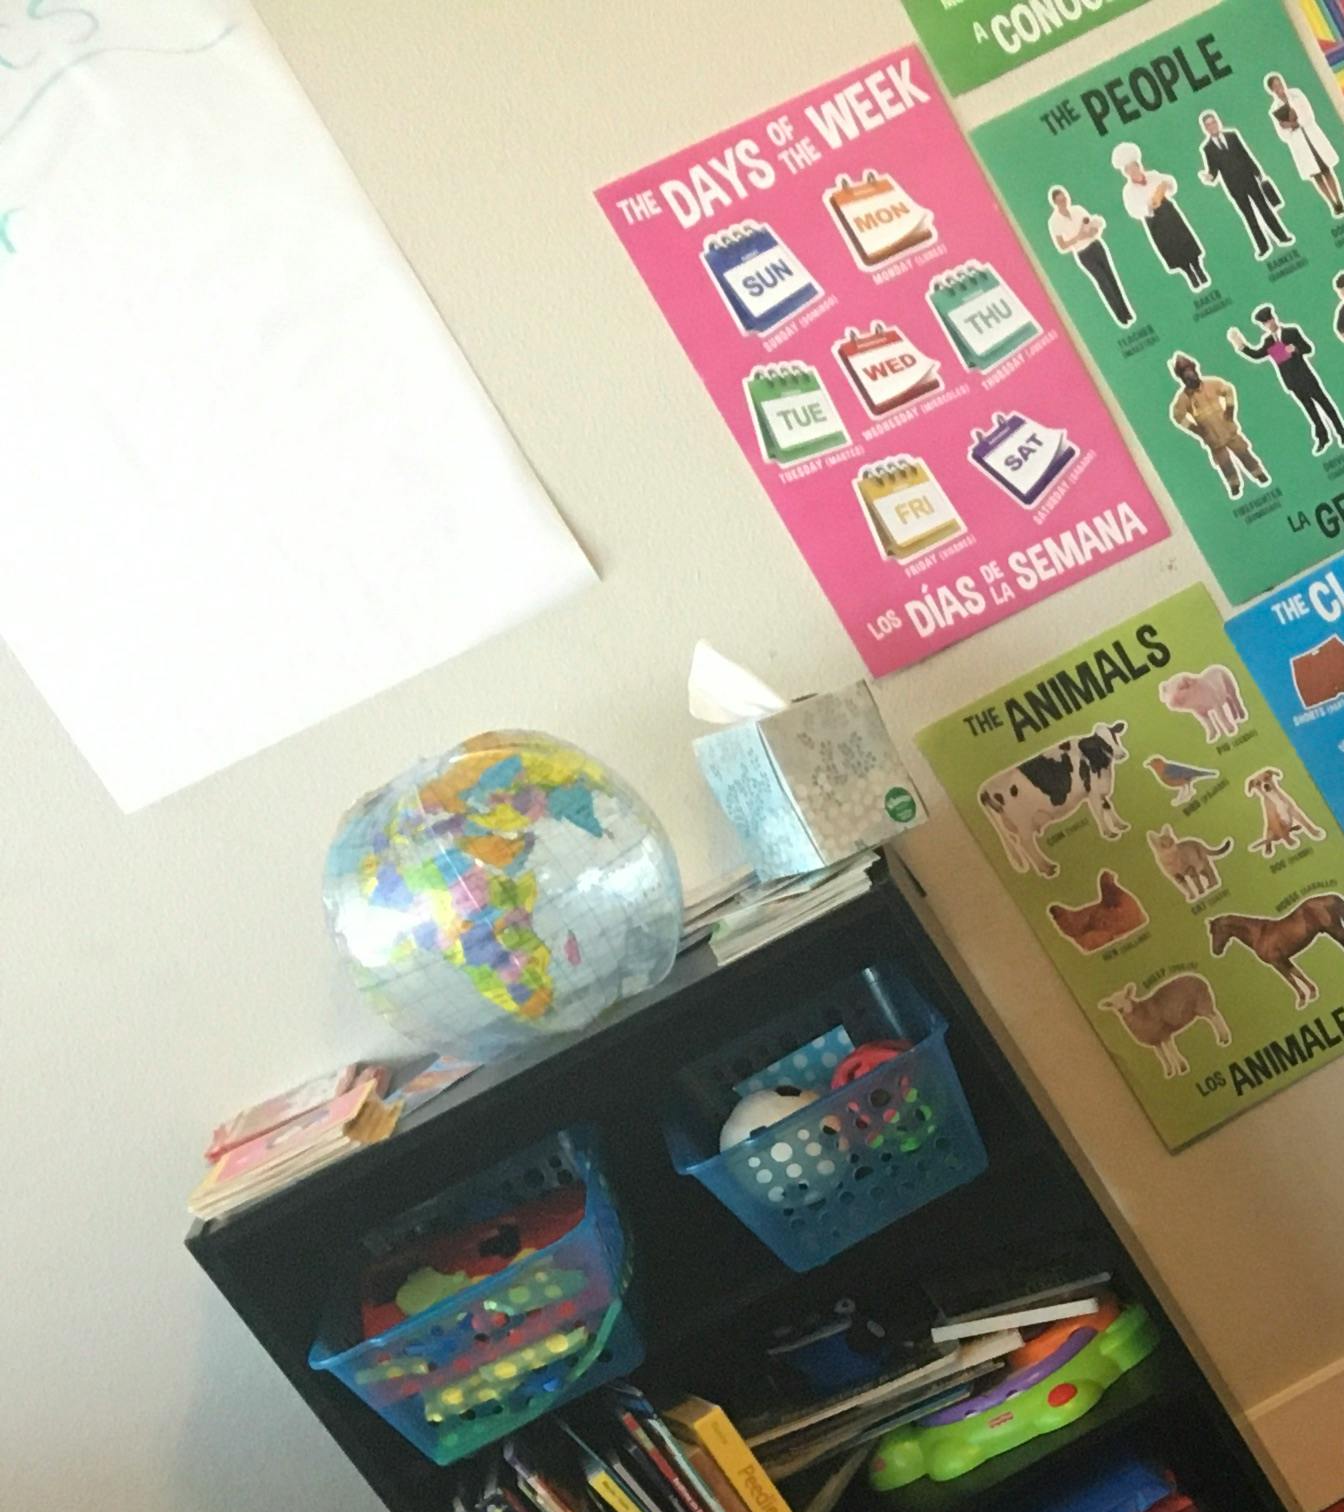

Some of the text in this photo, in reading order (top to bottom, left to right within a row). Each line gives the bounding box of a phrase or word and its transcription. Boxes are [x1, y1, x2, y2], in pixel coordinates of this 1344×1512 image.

[1040, 33, 1234, 137] THE PEOPLE
[616, 59, 931, 229] THE DAYS OF THE WEEK
[853, 201, 911, 234] MON
[741, 258, 795, 298] SUN
[963, 297, 1014, 336] THU
[862, 352, 917, 383] WED
[777, 402, 828, 433] TUE
[1003, 434, 1045, 473] SAT
[895, 498, 936, 527] FRI
[1287, 511, 1313, 534] LA
[1007, 501, 1148, 592] SEMANA
[979, 559, 1006, 584] DE
[905, 574, 987, 638] DÍAS
[989, 581, 1016, 606] LA
[867, 611, 903, 642] LOS
[1270, 594, 1312, 627] THE
[963, 624, 1171, 743] THE ANIMALS
[1195, 1070, 1227, 1098] LOS
